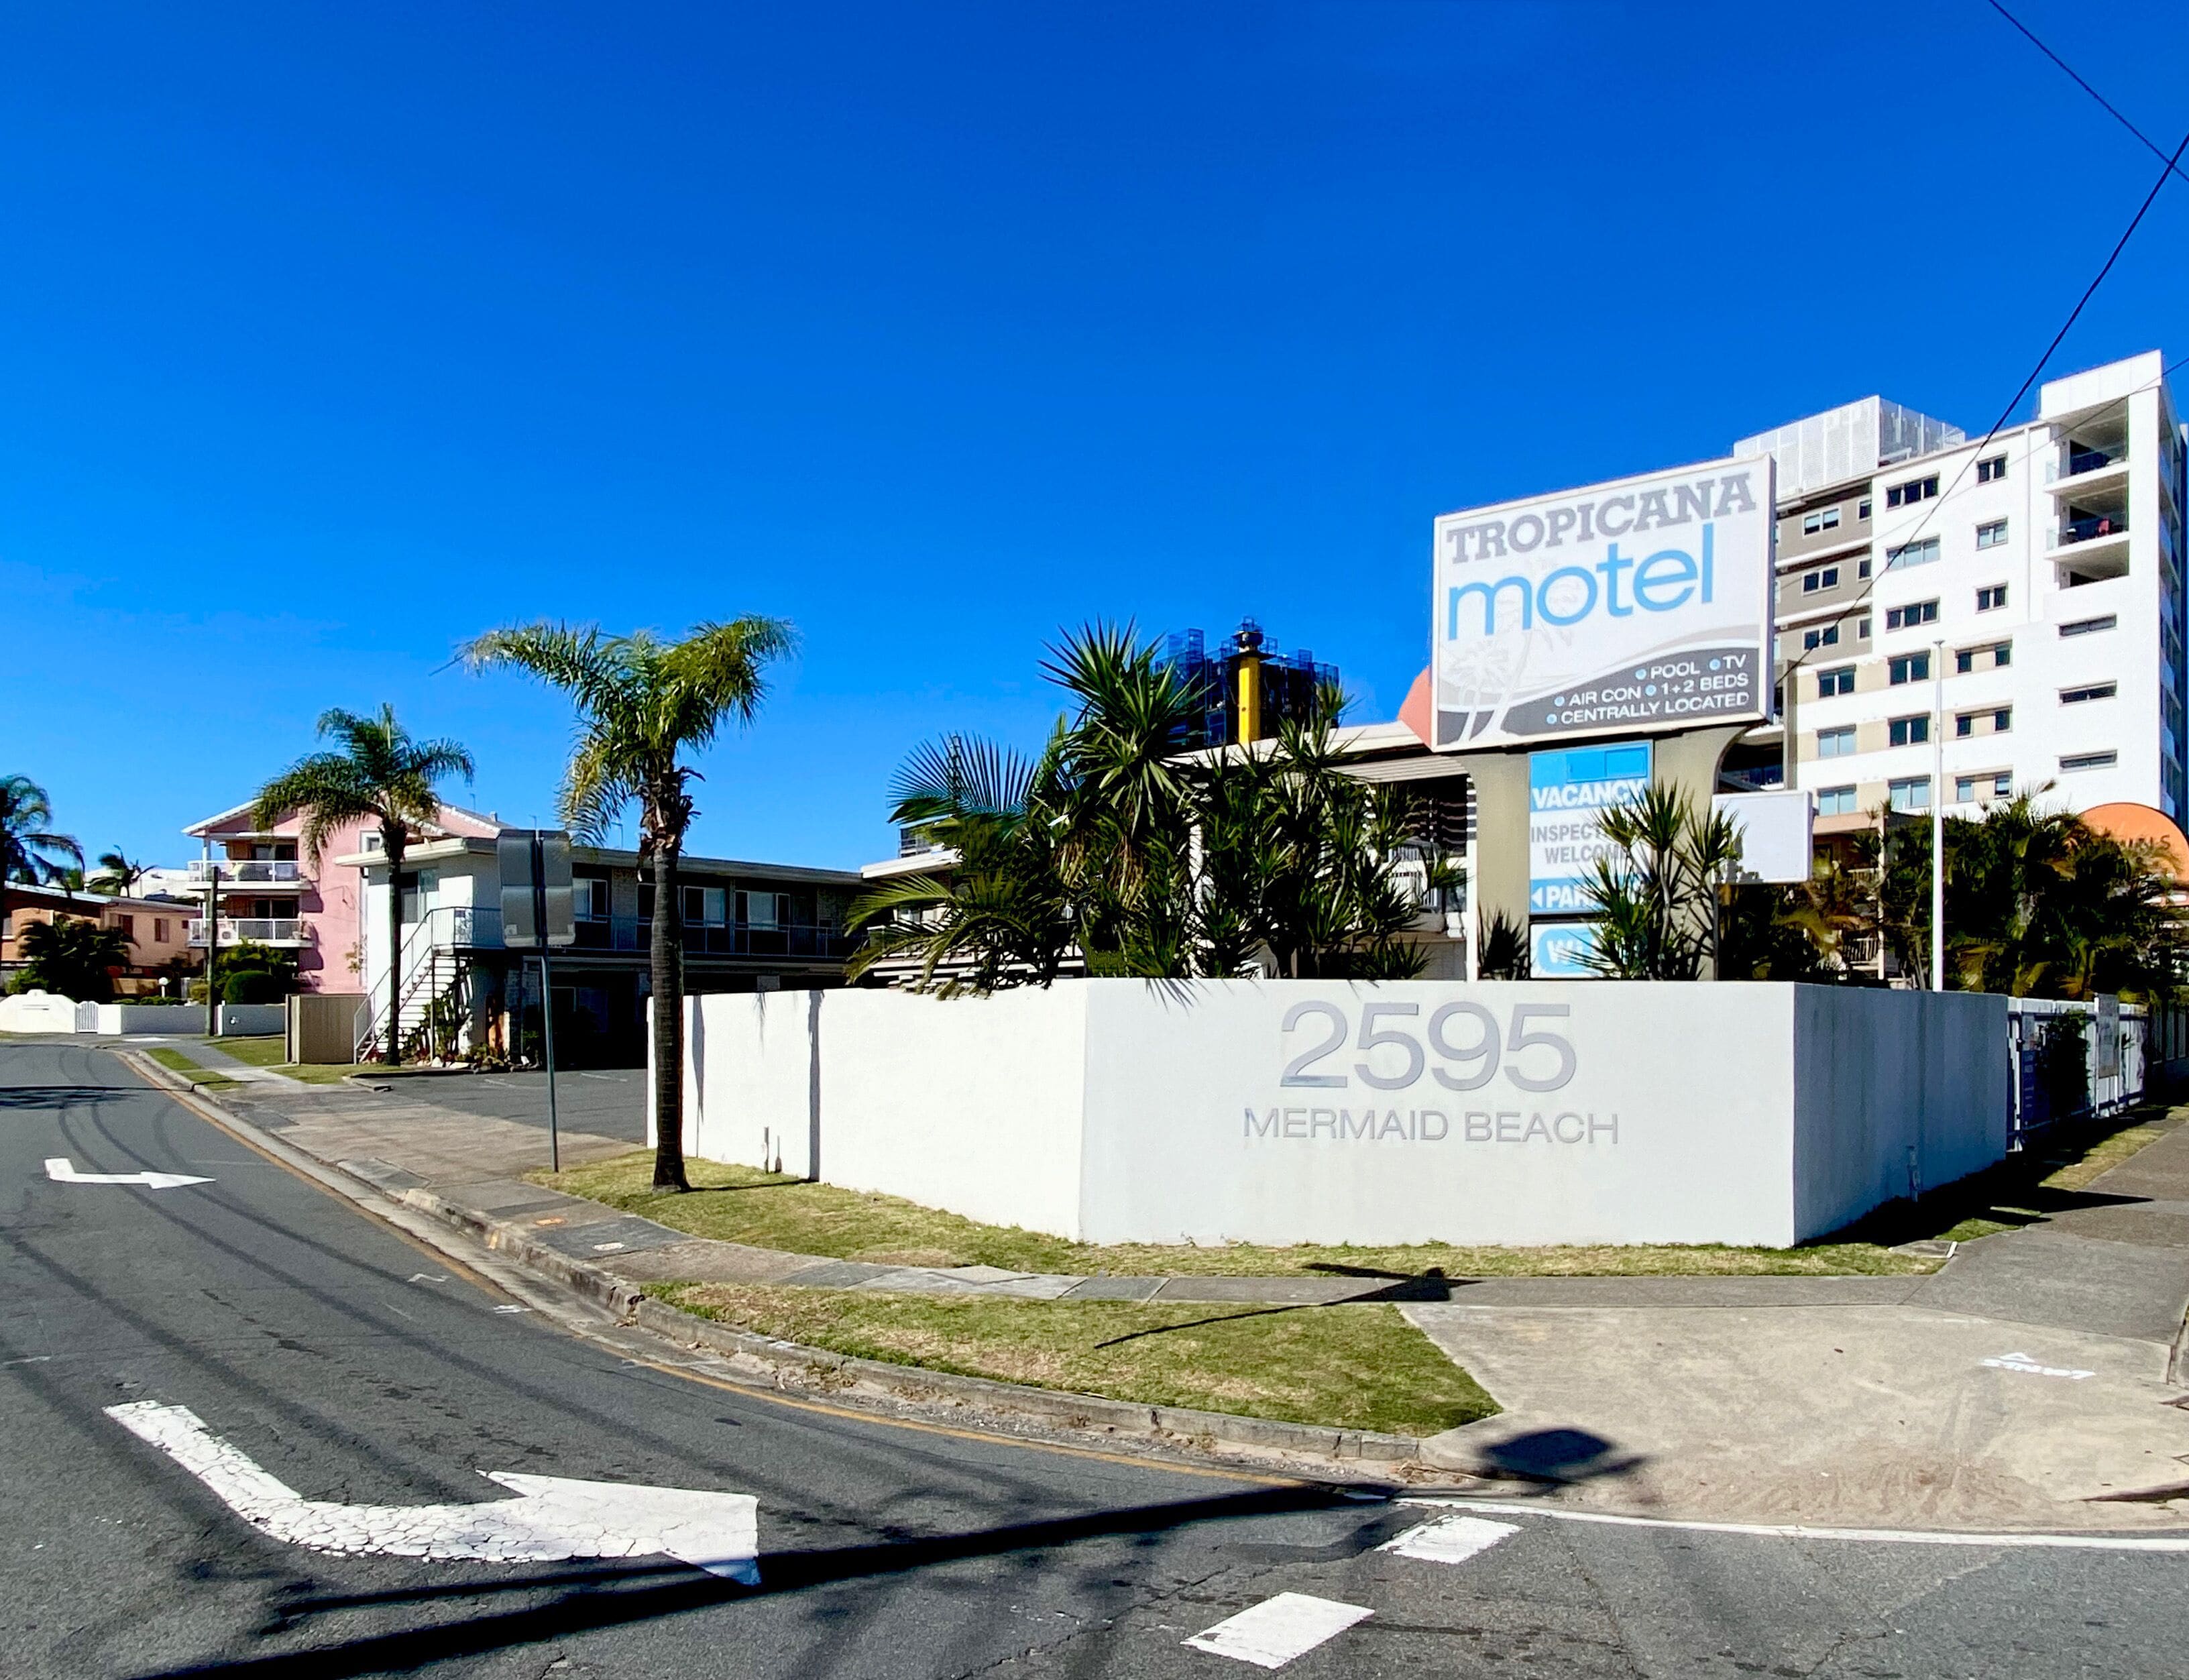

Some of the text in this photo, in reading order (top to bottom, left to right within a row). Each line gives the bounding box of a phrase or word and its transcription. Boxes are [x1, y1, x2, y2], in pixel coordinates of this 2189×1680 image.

[1446, 472, 1756, 565] TROPICANA
[1448, 522, 1714, 641] motel
[1650, 654, 1746, 679] POOL TV
[1569, 672, 1749, 707] AIR CON 1+2 BEDS
[1561, 691, 1749, 725] CENTRALLY LOCATED
[1532, 779, 1646, 809] VACANCY
[1280, 1001, 1576, 1093] 2595
[1244, 1108, 1618, 1144] MERMAID BEACH
